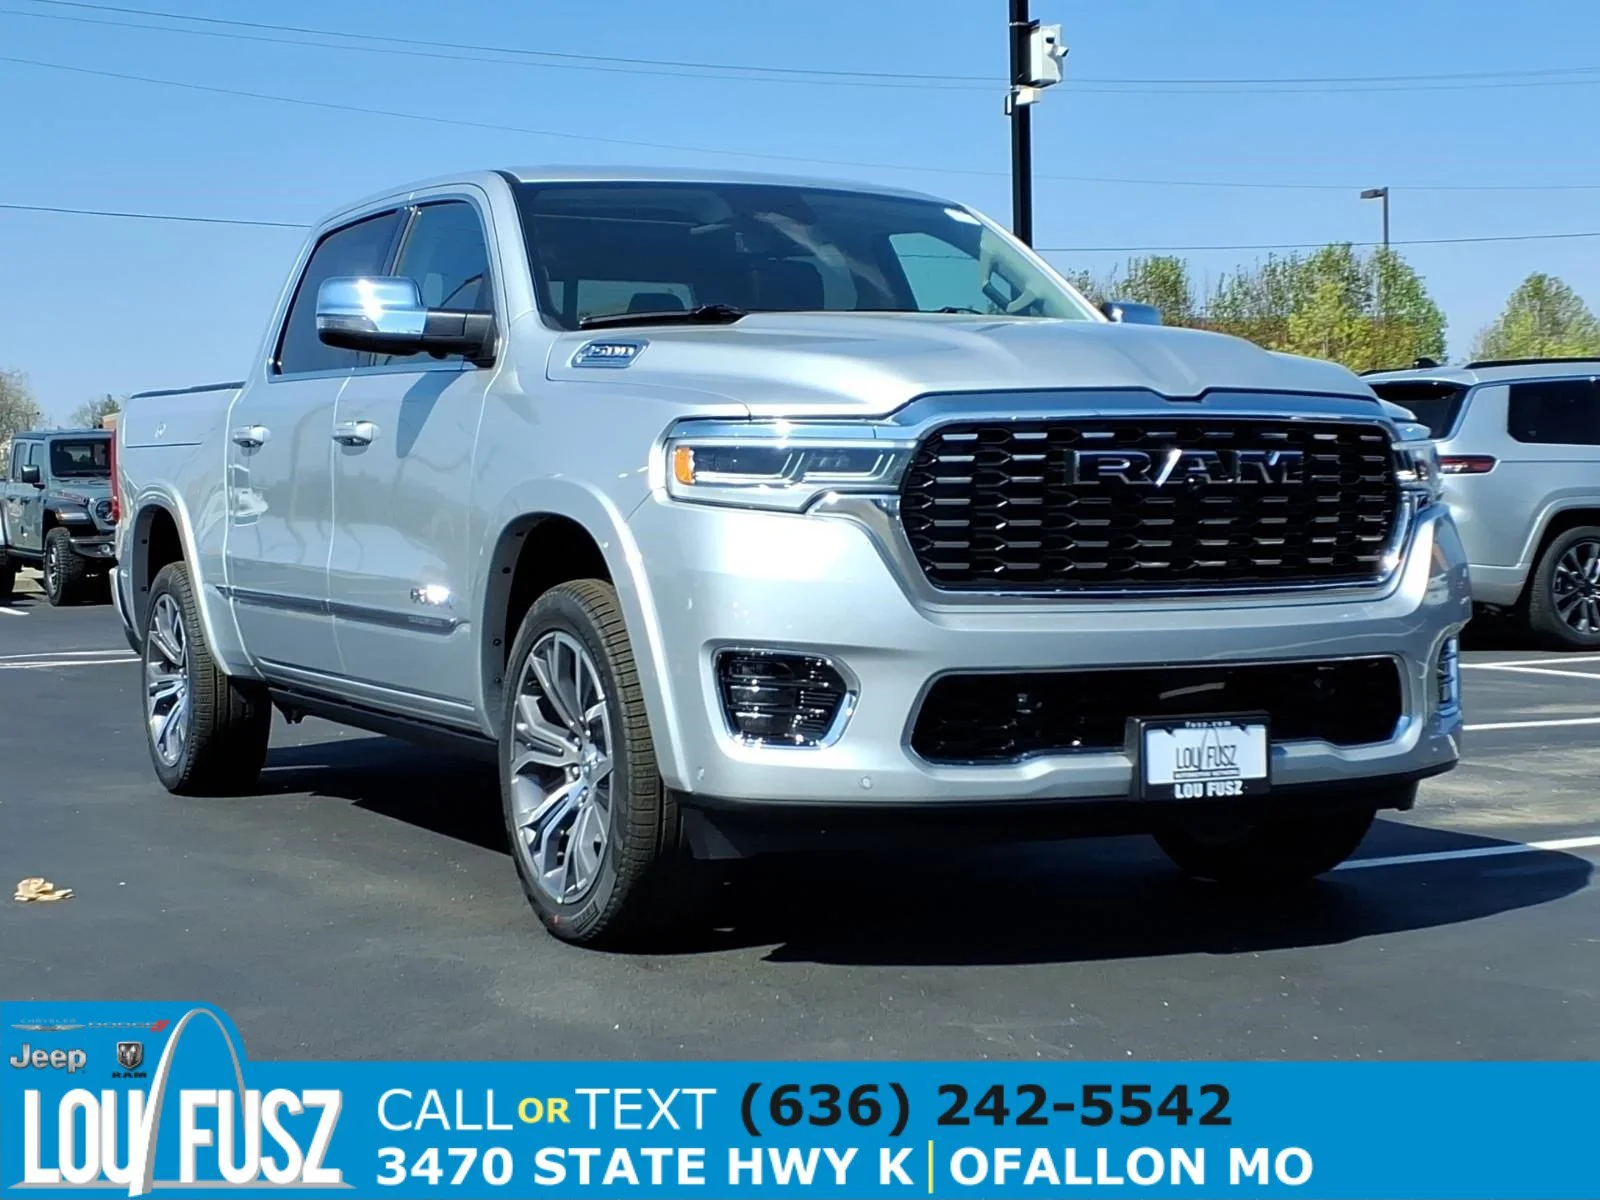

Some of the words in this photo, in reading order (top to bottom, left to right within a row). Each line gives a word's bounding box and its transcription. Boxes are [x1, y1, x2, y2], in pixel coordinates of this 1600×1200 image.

[1073, 449, 1303, 486] RAM
[1176, 746, 1202, 770] LOU
[1174, 782, 1204, 799] LOU
[1206, 780, 1244, 797] FUSZ
